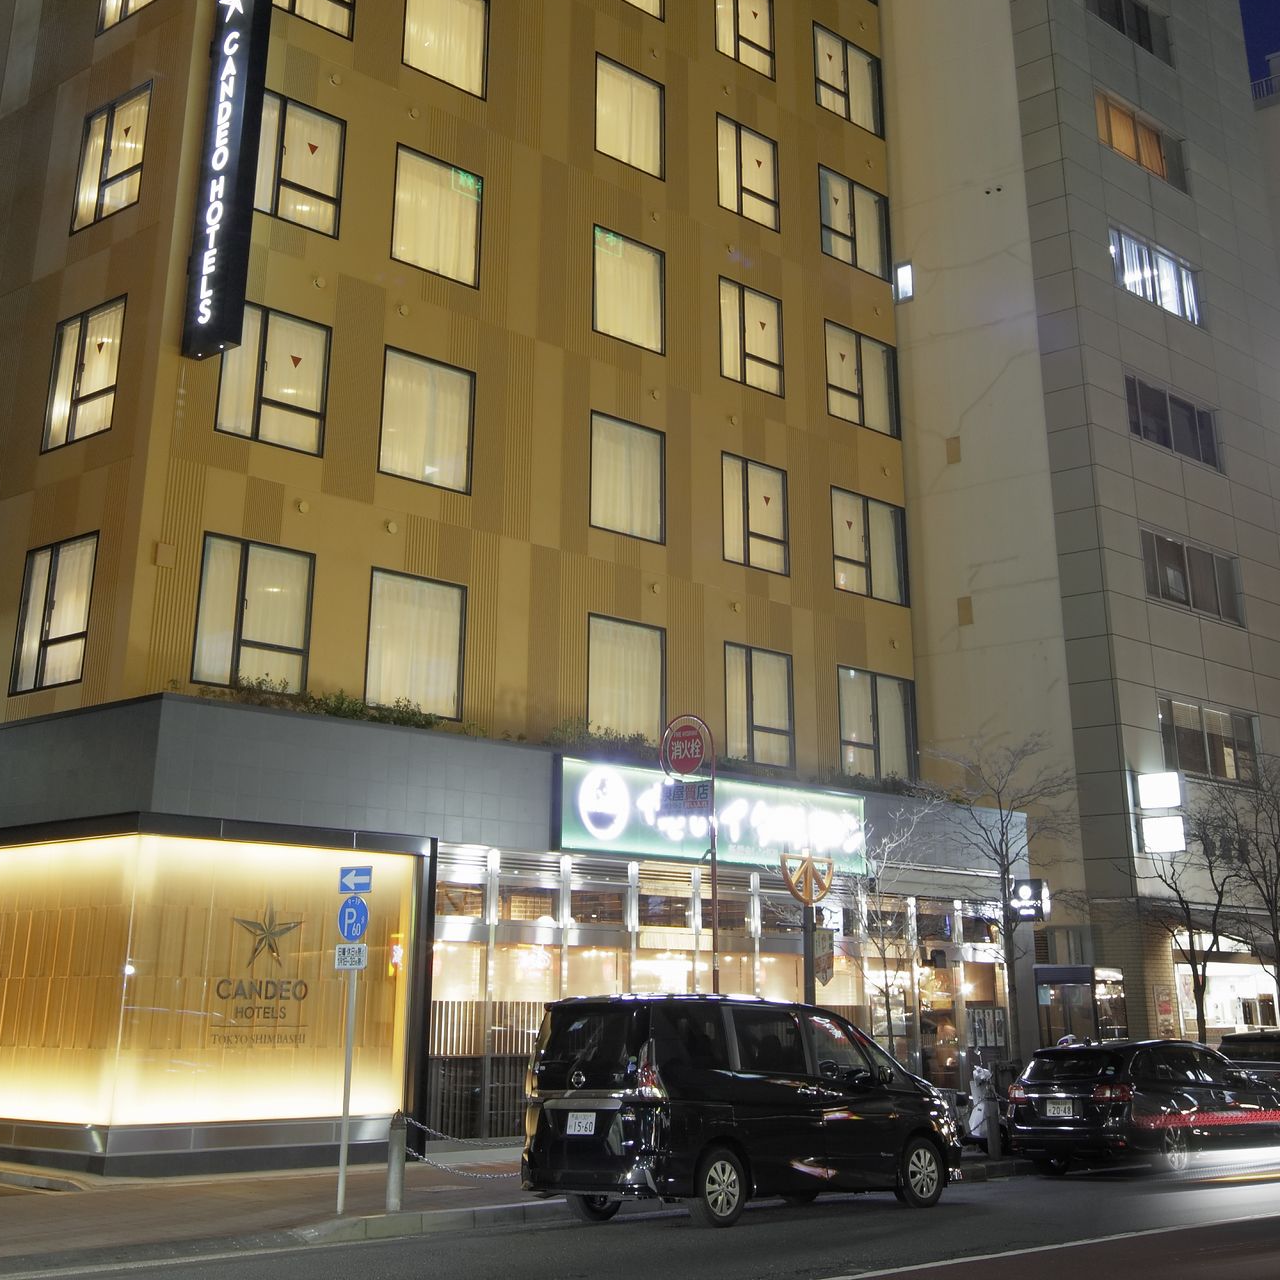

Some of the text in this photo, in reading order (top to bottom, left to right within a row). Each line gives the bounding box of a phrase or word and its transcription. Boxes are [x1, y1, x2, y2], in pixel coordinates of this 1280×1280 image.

[197, 31, 240, 324] CANDEO HOTELS
[671, 738, 702, 761] 消火栓
[344, 908, 357, 937] P
[216, 978, 308, 1000] CANDEO
[235, 1006, 287, 1020] HOTELS
[211, 1033, 248, 1045] TOKYO
